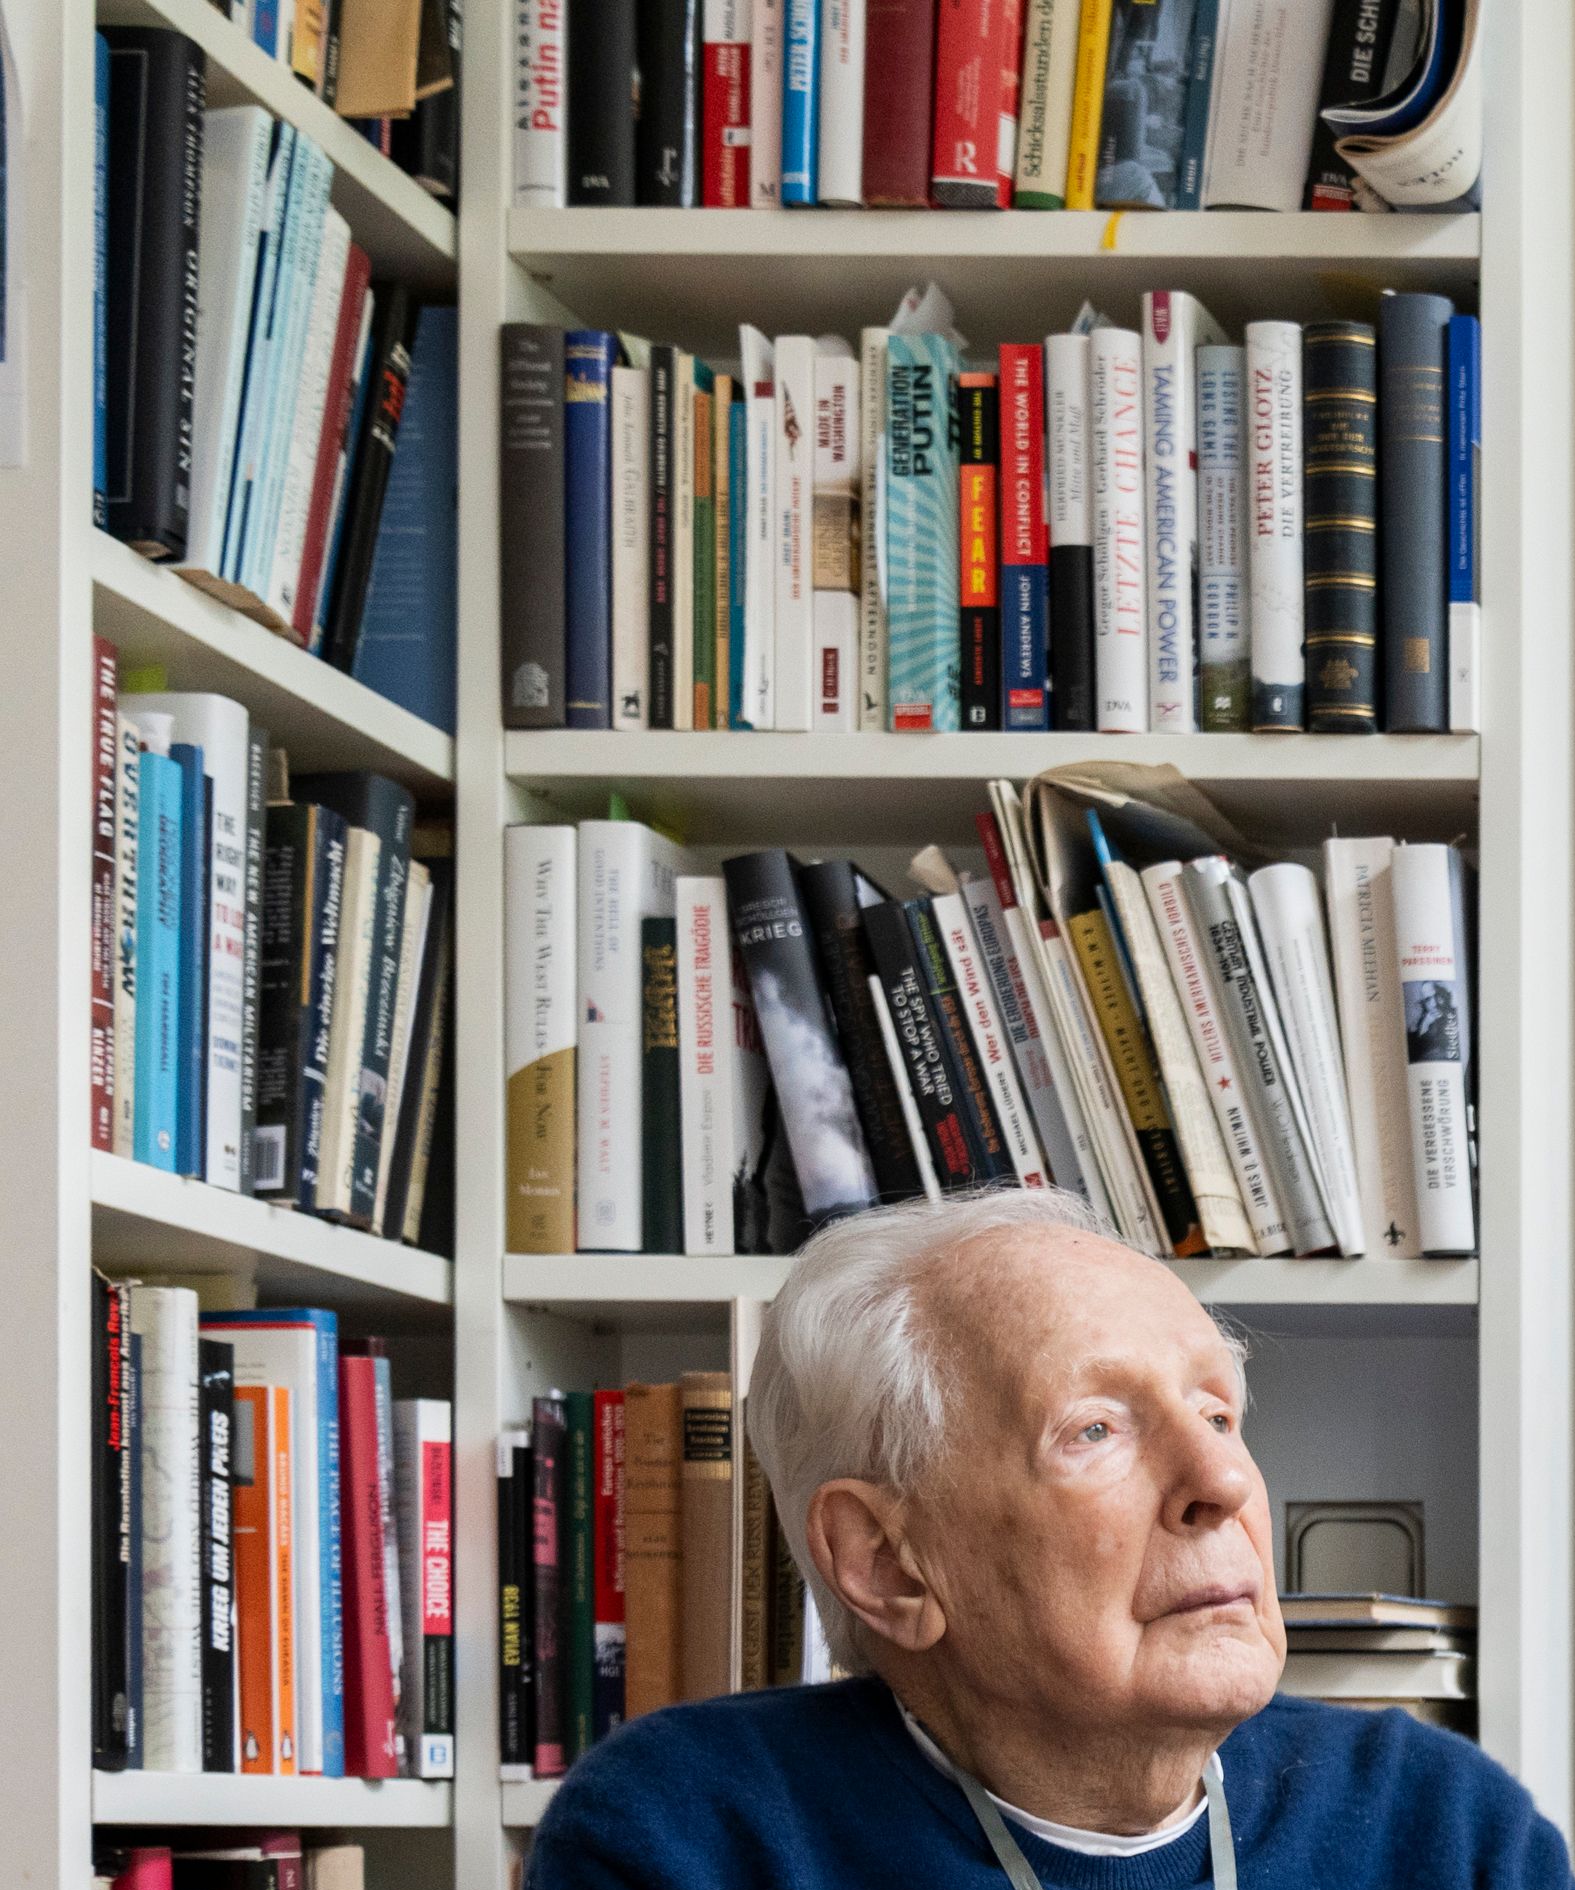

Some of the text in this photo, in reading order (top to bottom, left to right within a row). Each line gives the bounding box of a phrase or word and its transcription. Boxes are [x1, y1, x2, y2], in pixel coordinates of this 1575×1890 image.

[531, 42, 558, 132] Putin
[1022, 19, 1053, 178] Schicksalsstunden
[1348, 46, 1372, 83] DIE
[817, 416, 831, 449] MADE
[831, 385, 846, 463] WASHINGTON
[891, 365, 912, 477] GENERATION
[911, 363, 934, 477] PUTIN
[1014, 358, 1033, 559] THE WORLD IN CONFLICT
[1253, 367, 1275, 538] PETER GLOTZ
[1278, 369, 1295, 539] DIE VERTREIBUNG
[970, 474, 988, 593] FEAR
[1151, 364, 1179, 684] TAMING AMERICAN POWER
[1019, 575, 1033, 679] JOHN ANDREWS
[97, 656, 116, 838] THE TRUE FLAG
[321, 839, 345, 946] Weltmacht
[738, 919, 804, 947] KRIEG
[1158, 881, 1183, 928] VORBILD
[241, 826, 262, 1111] THE NEW AMERICAN MILITARISM
[317, 951, 337, 1026] einzige
[690, 905, 714, 1075] DIE RUSSISCHE TRAGÖDIE
[889, 983, 909, 1008] TO
[900, 965, 921, 996] THE
[908, 996, 928, 1022] SPY
[949, 927, 1003, 1066] Wer den Wind sät
[973, 903, 1029, 1044] DIE EROBERUNG EUROPAS
[896, 1007, 920, 1046] STOP
[915, 1024, 940, 1063] WHO
[914, 1062, 936, 1097] WAR
[930, 1062, 954, 1106] TRIED
[1226, 1106, 1269, 1209] JAMES WHITMAN
[1422, 1079, 1439, 1190] DIE VERGESSENE
[1437, 1078, 1457, 1189] VERSCHWÖRUNG
[209, 1476, 231, 1546] JEDEN
[426, 1519, 449, 1551] THE
[209, 1541, 230, 1583] UM
[426, 1553, 449, 1619] CHOICE
[209, 1582, 231, 1653] KRIEG
[502, 1620, 520, 1666] EVIAN
